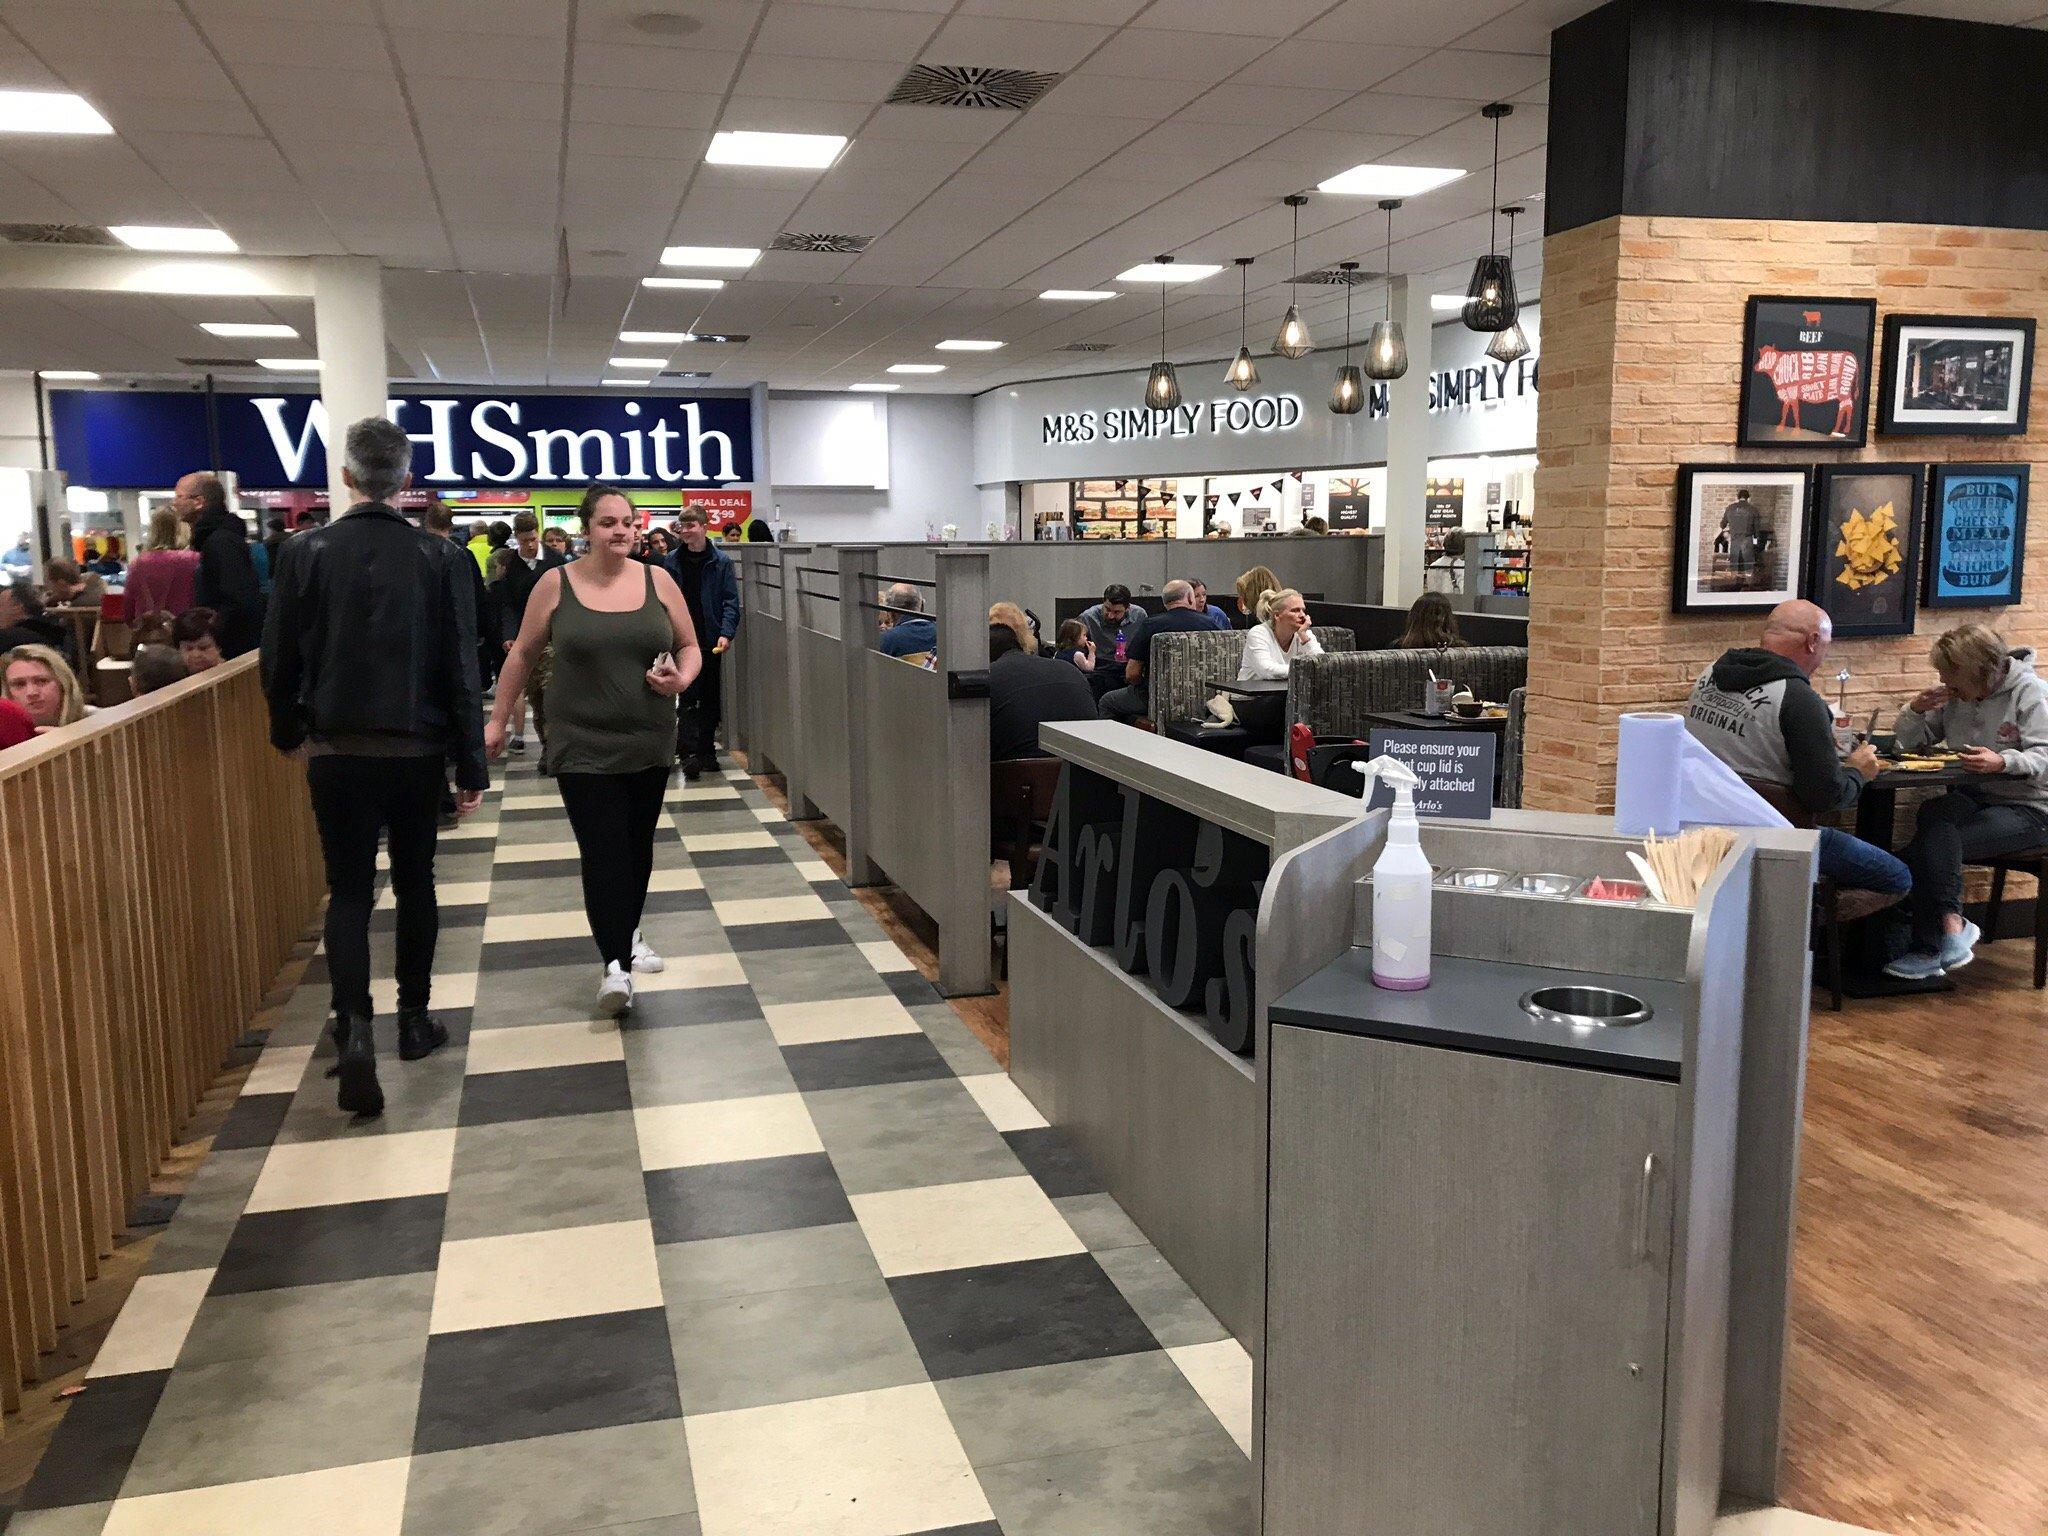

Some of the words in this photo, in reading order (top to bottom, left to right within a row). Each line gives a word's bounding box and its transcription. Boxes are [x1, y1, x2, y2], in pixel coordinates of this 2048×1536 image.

[1799, 331, 1824, 343] BEEF
[1801, 352, 1815, 380] RIB
[1813, 353, 1829, 378] LOIN
[1840, 355, 1857, 396] ROUND
[1043, 413, 1095, 443] M&S
[1103, 403, 1201, 440] SIMPLY
[1210, 397, 1299, 433] FOOD
[1966, 484, 1998, 496] BUN
[689, 498, 717, 507] MEAL
[719, 498, 747, 507] DEAL
[1954, 516, 2004, 527] CHEESE
[1952, 528, 2003, 540] MEAT
[1960, 574, 1992, 586] BUN
[1690, 704, 1745, 738] ORIGINAL
[1383, 740, 1417, 755] Please
[1420, 743, 1455, 756] ensure
[1456, 746, 1480, 758] your
[1417, 763, 1436, 775] cup
[1439, 759, 1452, 773] lid
[1454, 760, 1464, 774] is
[1429, 778, 1475, 792] attached
[1415, 801, 1443, 811] Arlo's
[1028, 760, 1257, 1053] Arlo's
